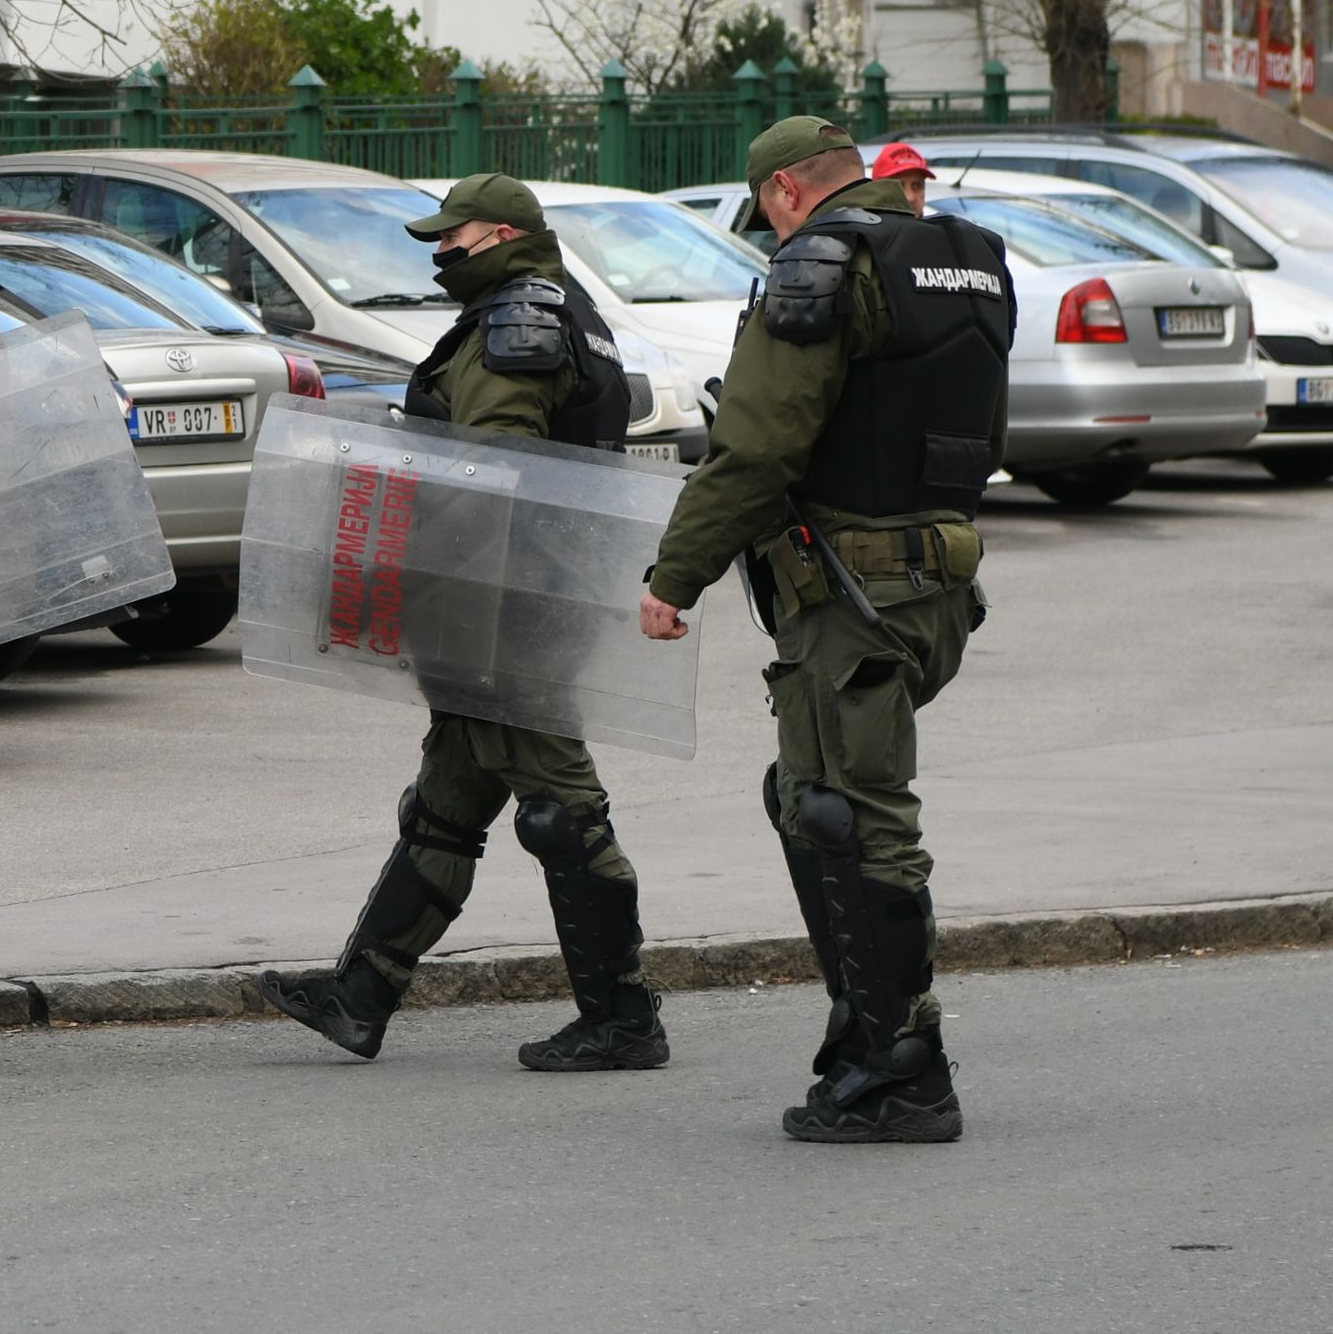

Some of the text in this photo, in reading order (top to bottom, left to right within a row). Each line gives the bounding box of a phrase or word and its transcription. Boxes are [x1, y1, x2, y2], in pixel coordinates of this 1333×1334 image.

[910, 266, 1003, 297] ЖАНДАРМЕРИЈА
[143, 409, 166, 435] VR
[329, 464, 380, 650] ЖАНДАРМЕРИЈА
[368, 467, 421, 657] GENDARMERIE
